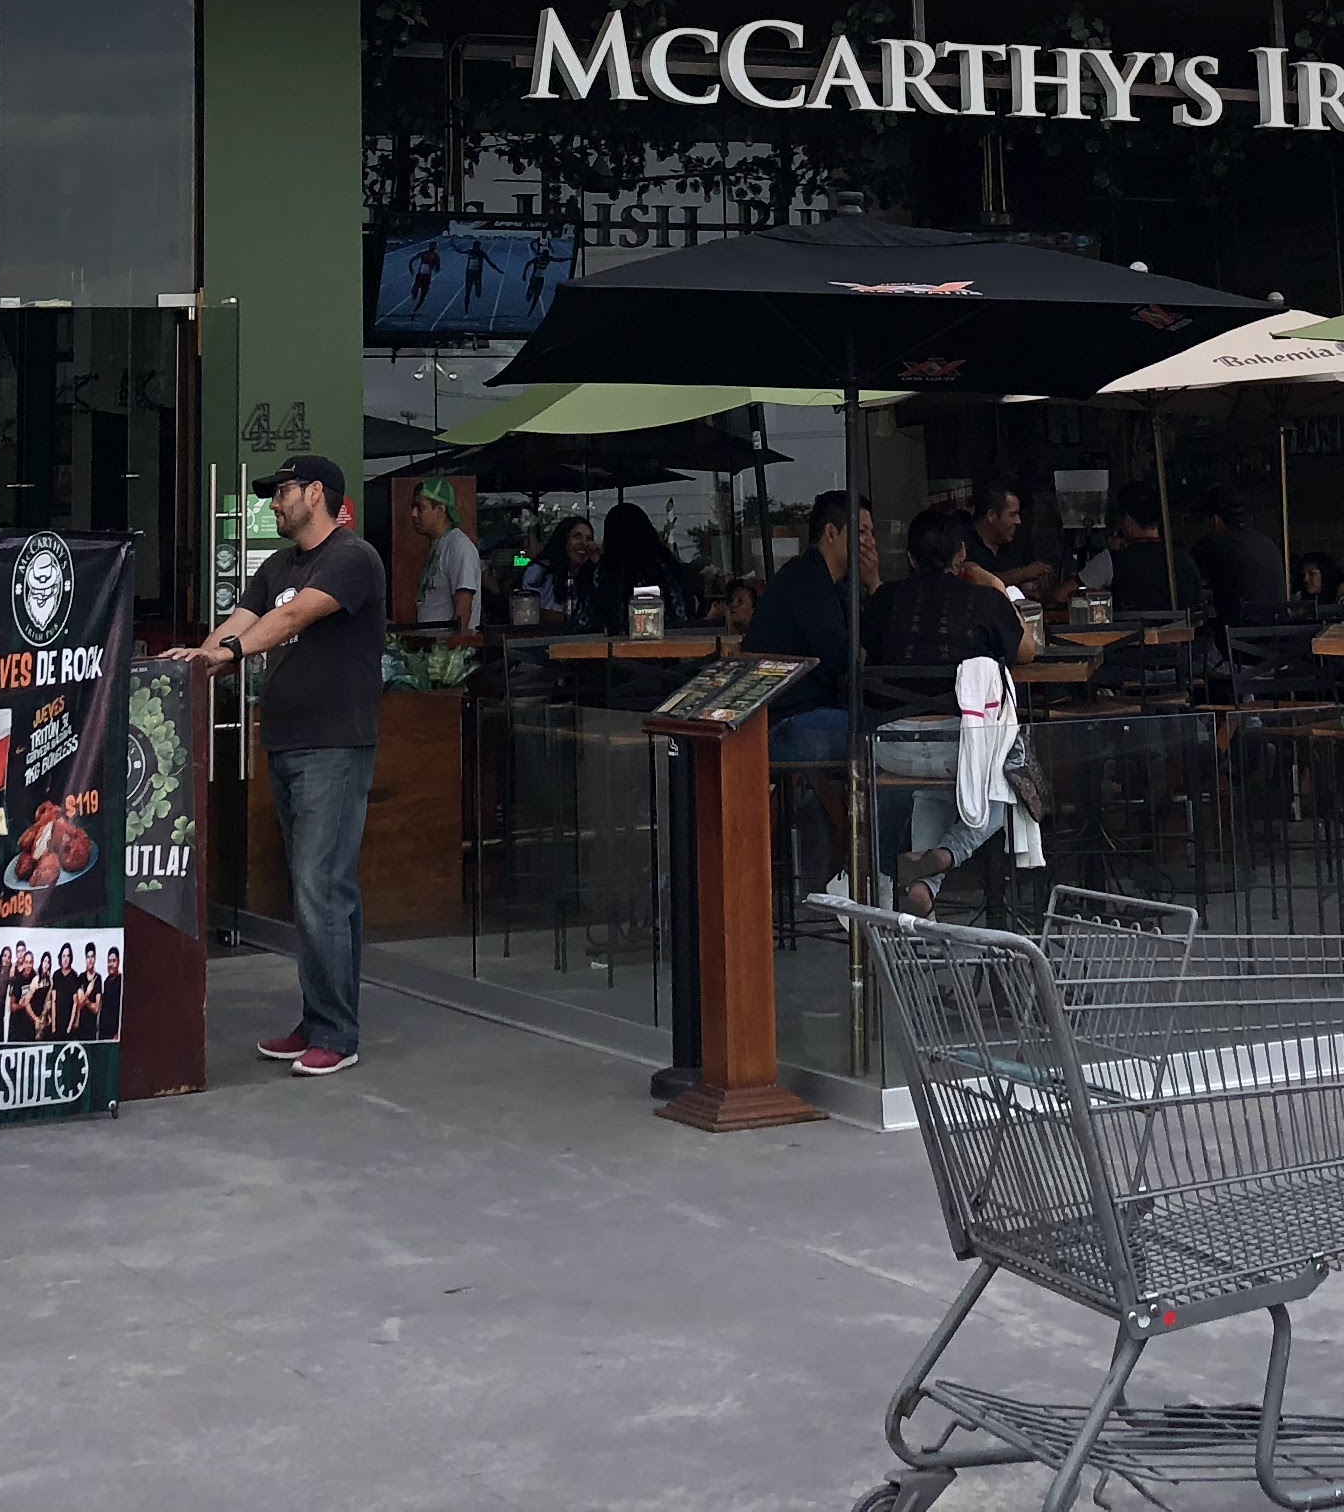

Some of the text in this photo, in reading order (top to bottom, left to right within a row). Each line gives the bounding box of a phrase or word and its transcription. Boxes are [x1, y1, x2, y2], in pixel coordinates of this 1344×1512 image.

[1212, 345, 1336, 369] Bohemia
[35, 649, 57, 687] DE
[60, 644, 104, 684] ROCK
[32, 694, 66, 729] JUEVES
[125, 844, 191, 877] UTLA!
